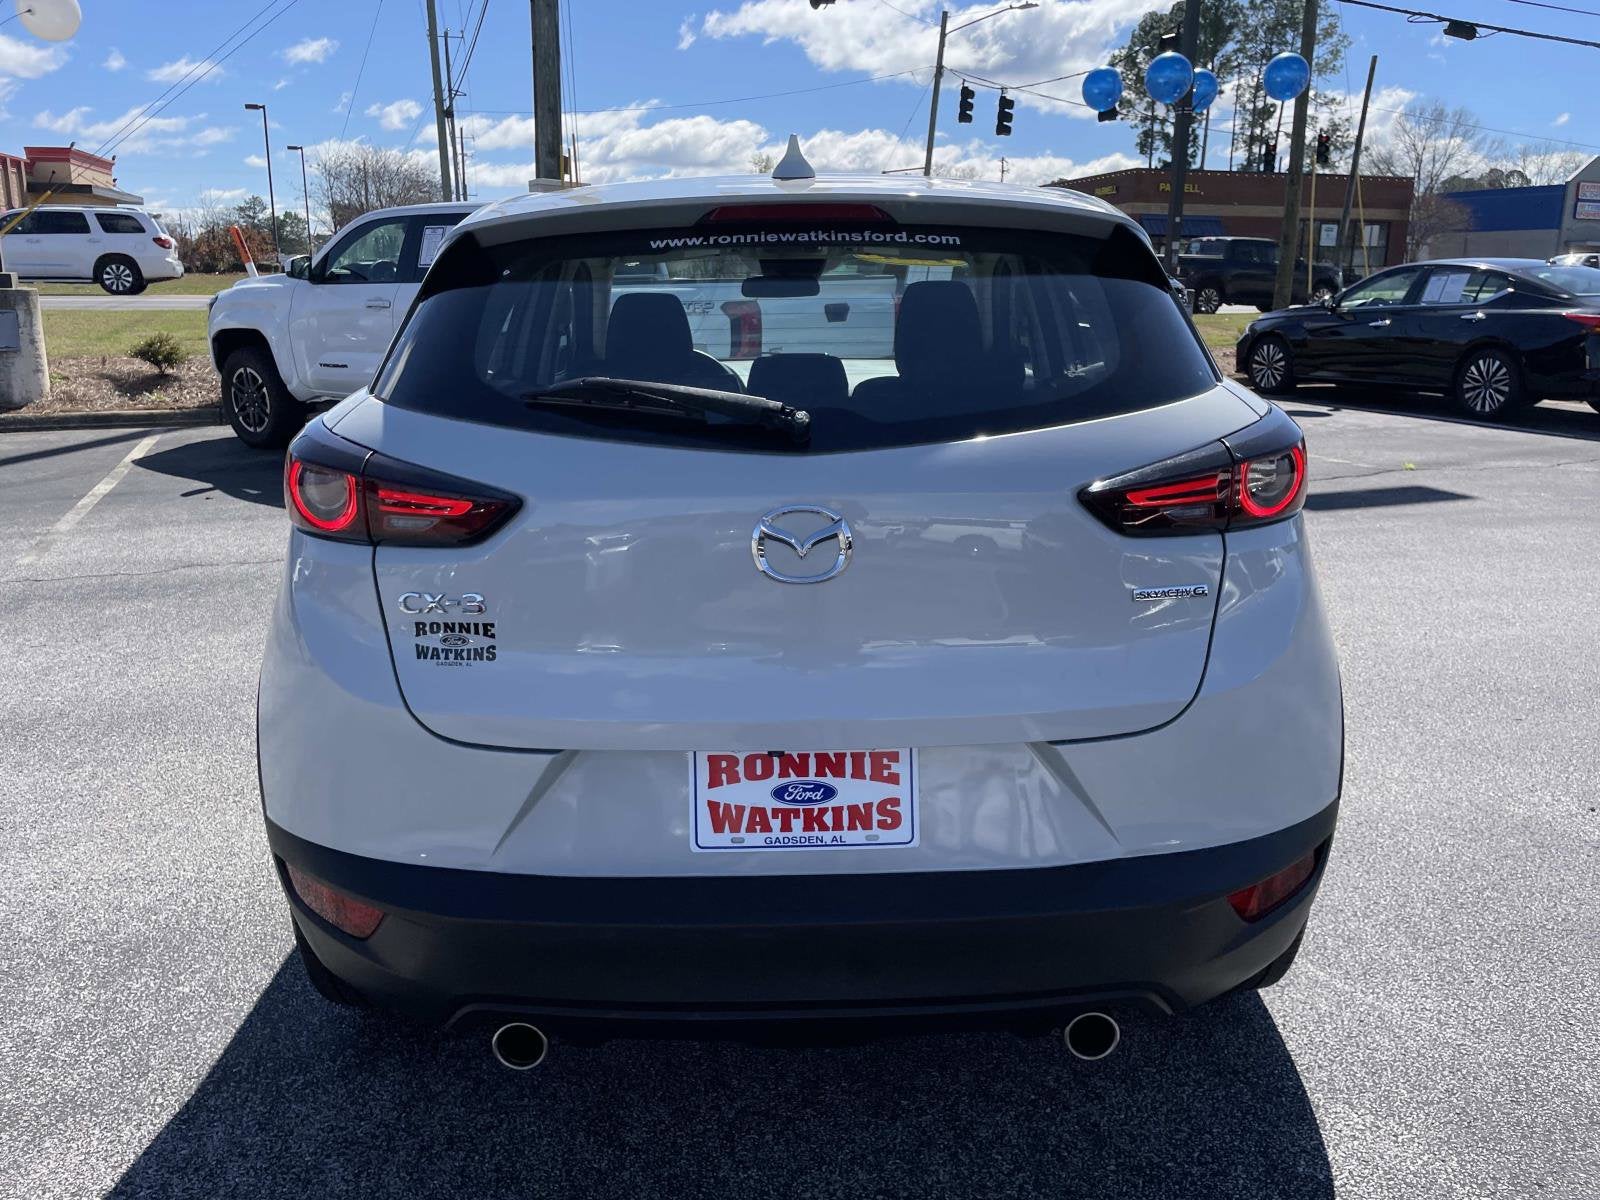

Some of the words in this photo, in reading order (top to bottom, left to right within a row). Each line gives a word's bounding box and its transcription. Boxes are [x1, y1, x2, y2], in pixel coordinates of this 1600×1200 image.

[1159, 182, 1201, 193] PAELL
[650, 231, 961, 249] www.ronniewatkinsford.com
[398, 591, 487, 615] CX-3
[414, 621, 496, 639] RONNIE
[414, 643, 497, 662] WATKINS
[707, 751, 900, 789] RONNIE
[783, 784, 824, 801] Ford
[707, 797, 903, 833] WATKINS
[764, 836, 827, 846] GADSDEN,
[830, 835, 847, 845] AL
